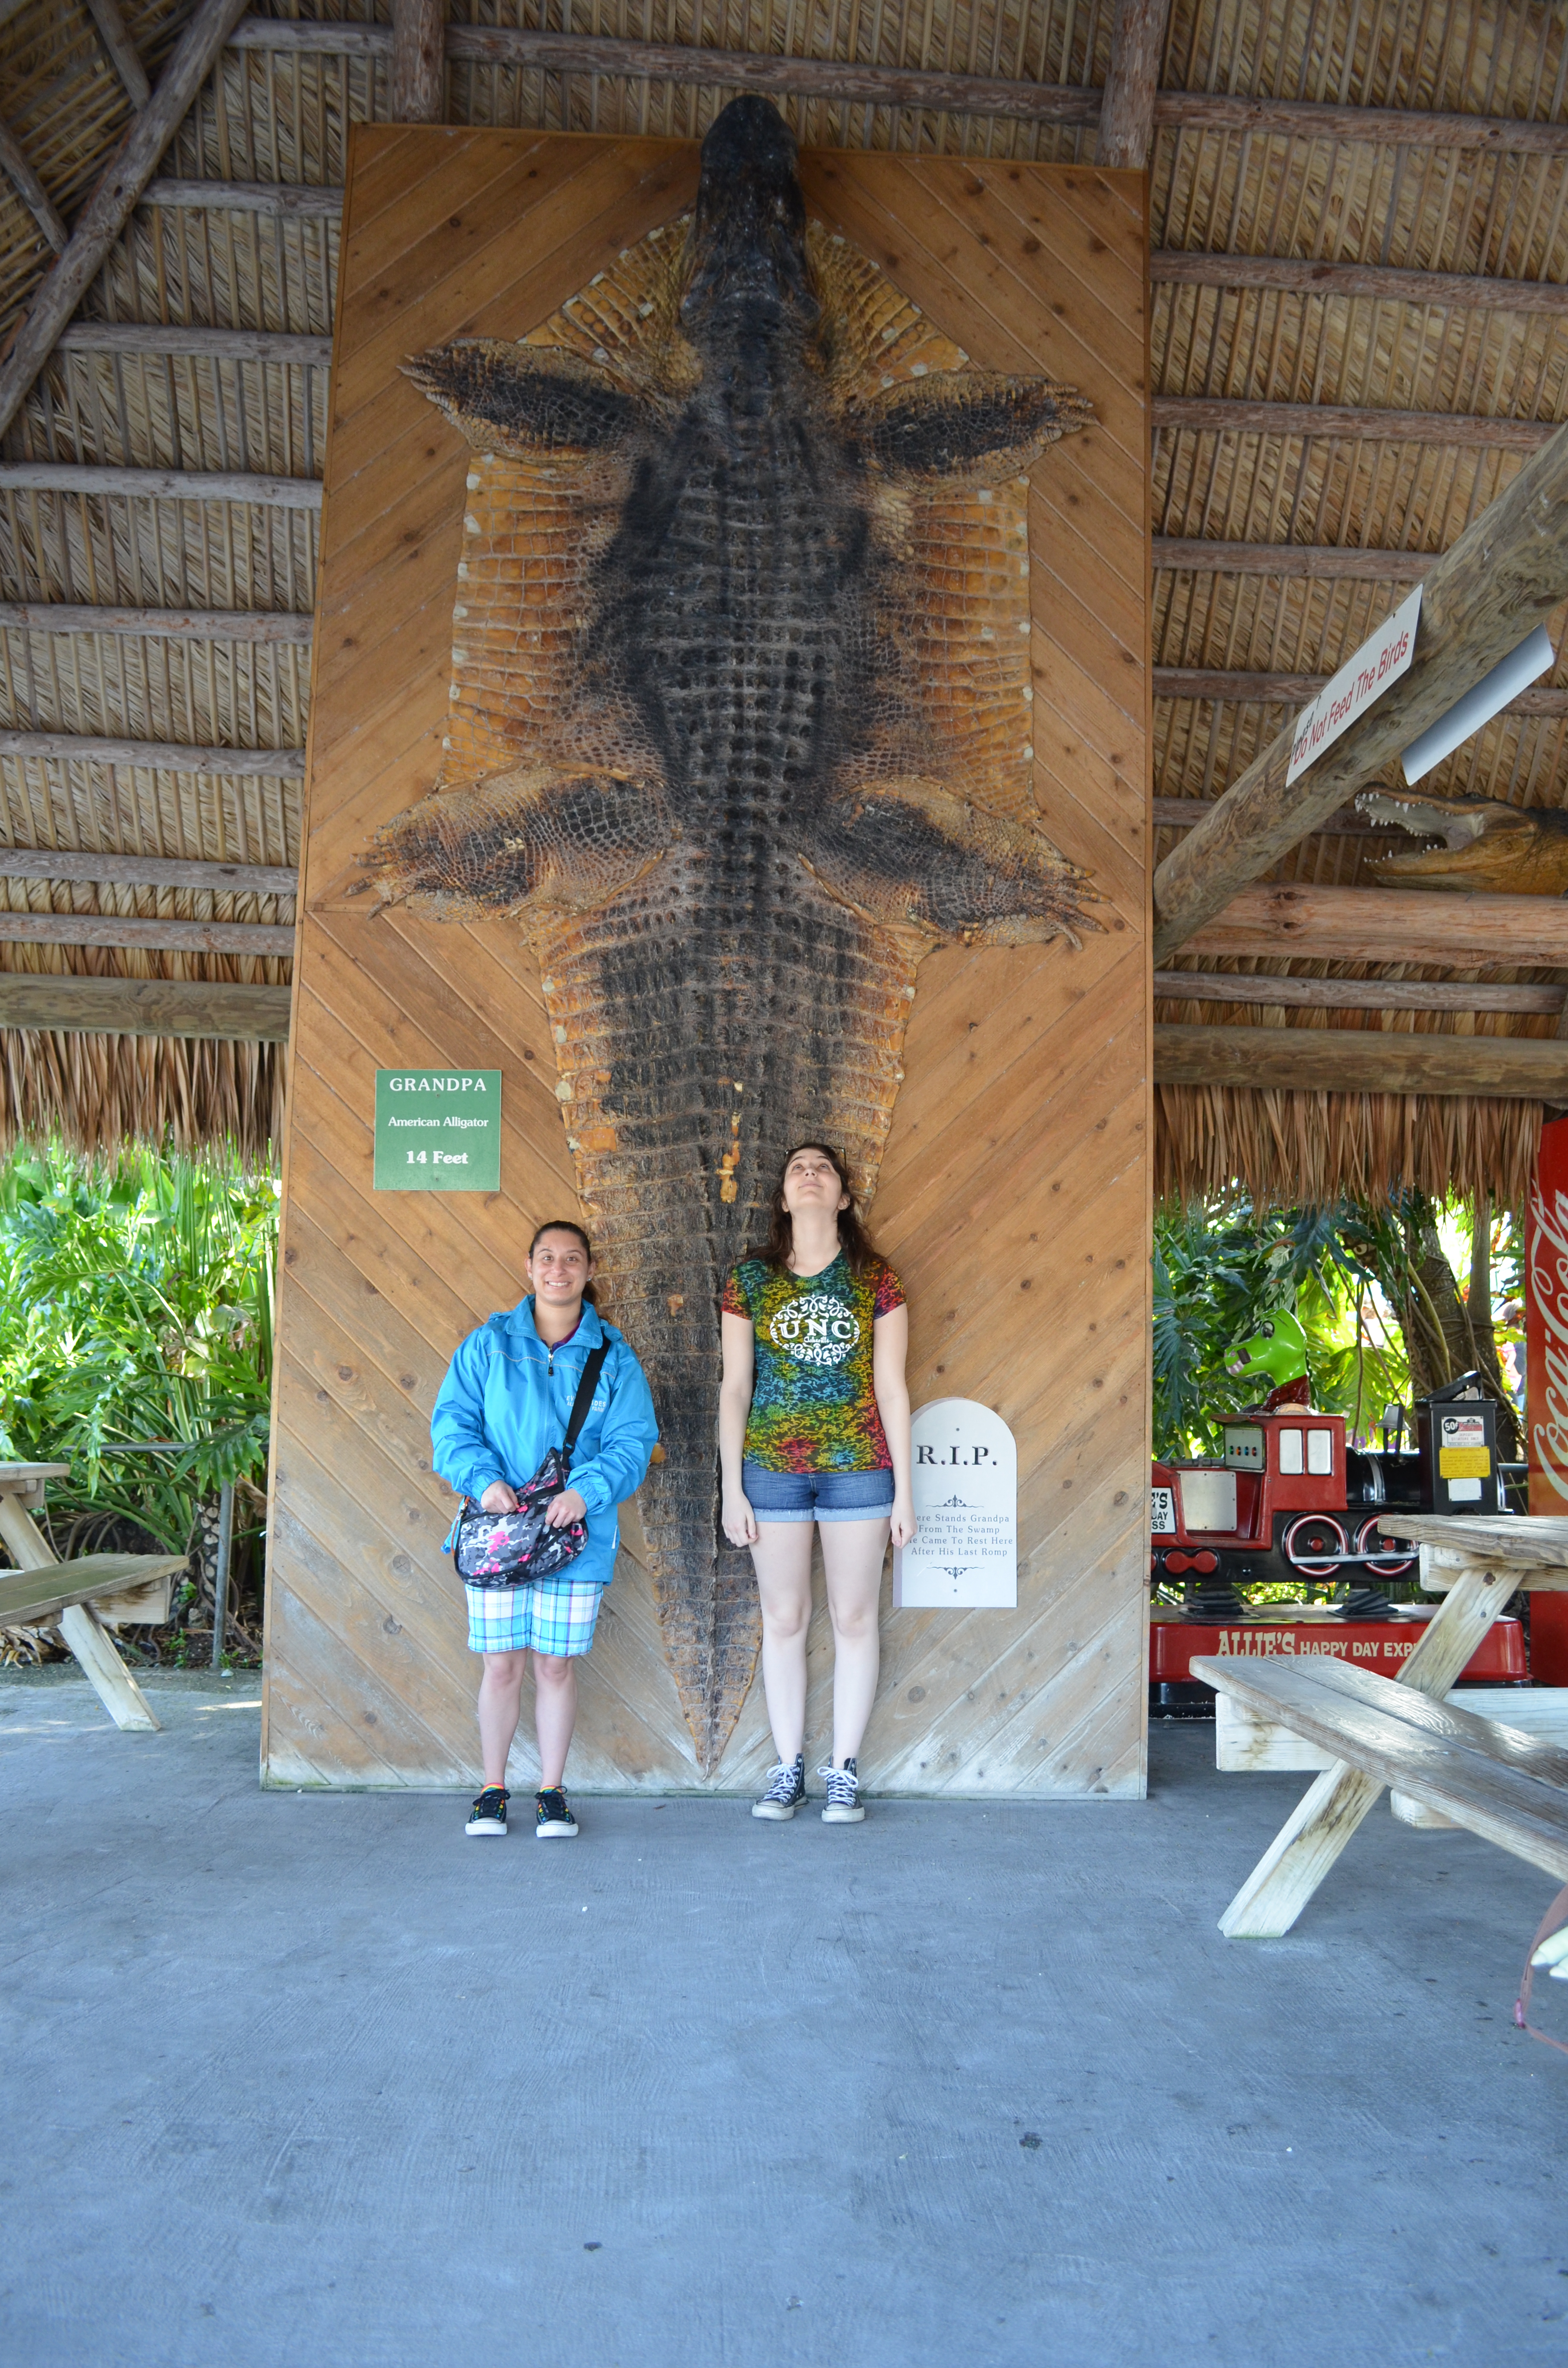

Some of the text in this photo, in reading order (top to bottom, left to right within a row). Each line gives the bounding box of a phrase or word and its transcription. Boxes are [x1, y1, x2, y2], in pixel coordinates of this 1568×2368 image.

[1293, 630, 1409, 766] Do Not Feed The Birds
[389, 1078, 487, 1091] GRANDPA
[388, 1116, 489, 1129] American Alligator
[406, 1150, 468, 1164] 14 Feet
[777, 1319, 852, 1339] UNC
[916, 1444, 998, 1466] R.I.P.
[935, 1514, 966, 1522] Stands
[970, 1515, 1009, 1524] Grandpa
[968, 1526, 1000, 1534] Swamp
[982, 1548, 1007, 1557] Romp
[1216, 1630, 1296, 1658] ALLIE'S
[1300, 1641, 1348, 1656] HAPPY
[1353, 1641, 1380, 1657] DAY
